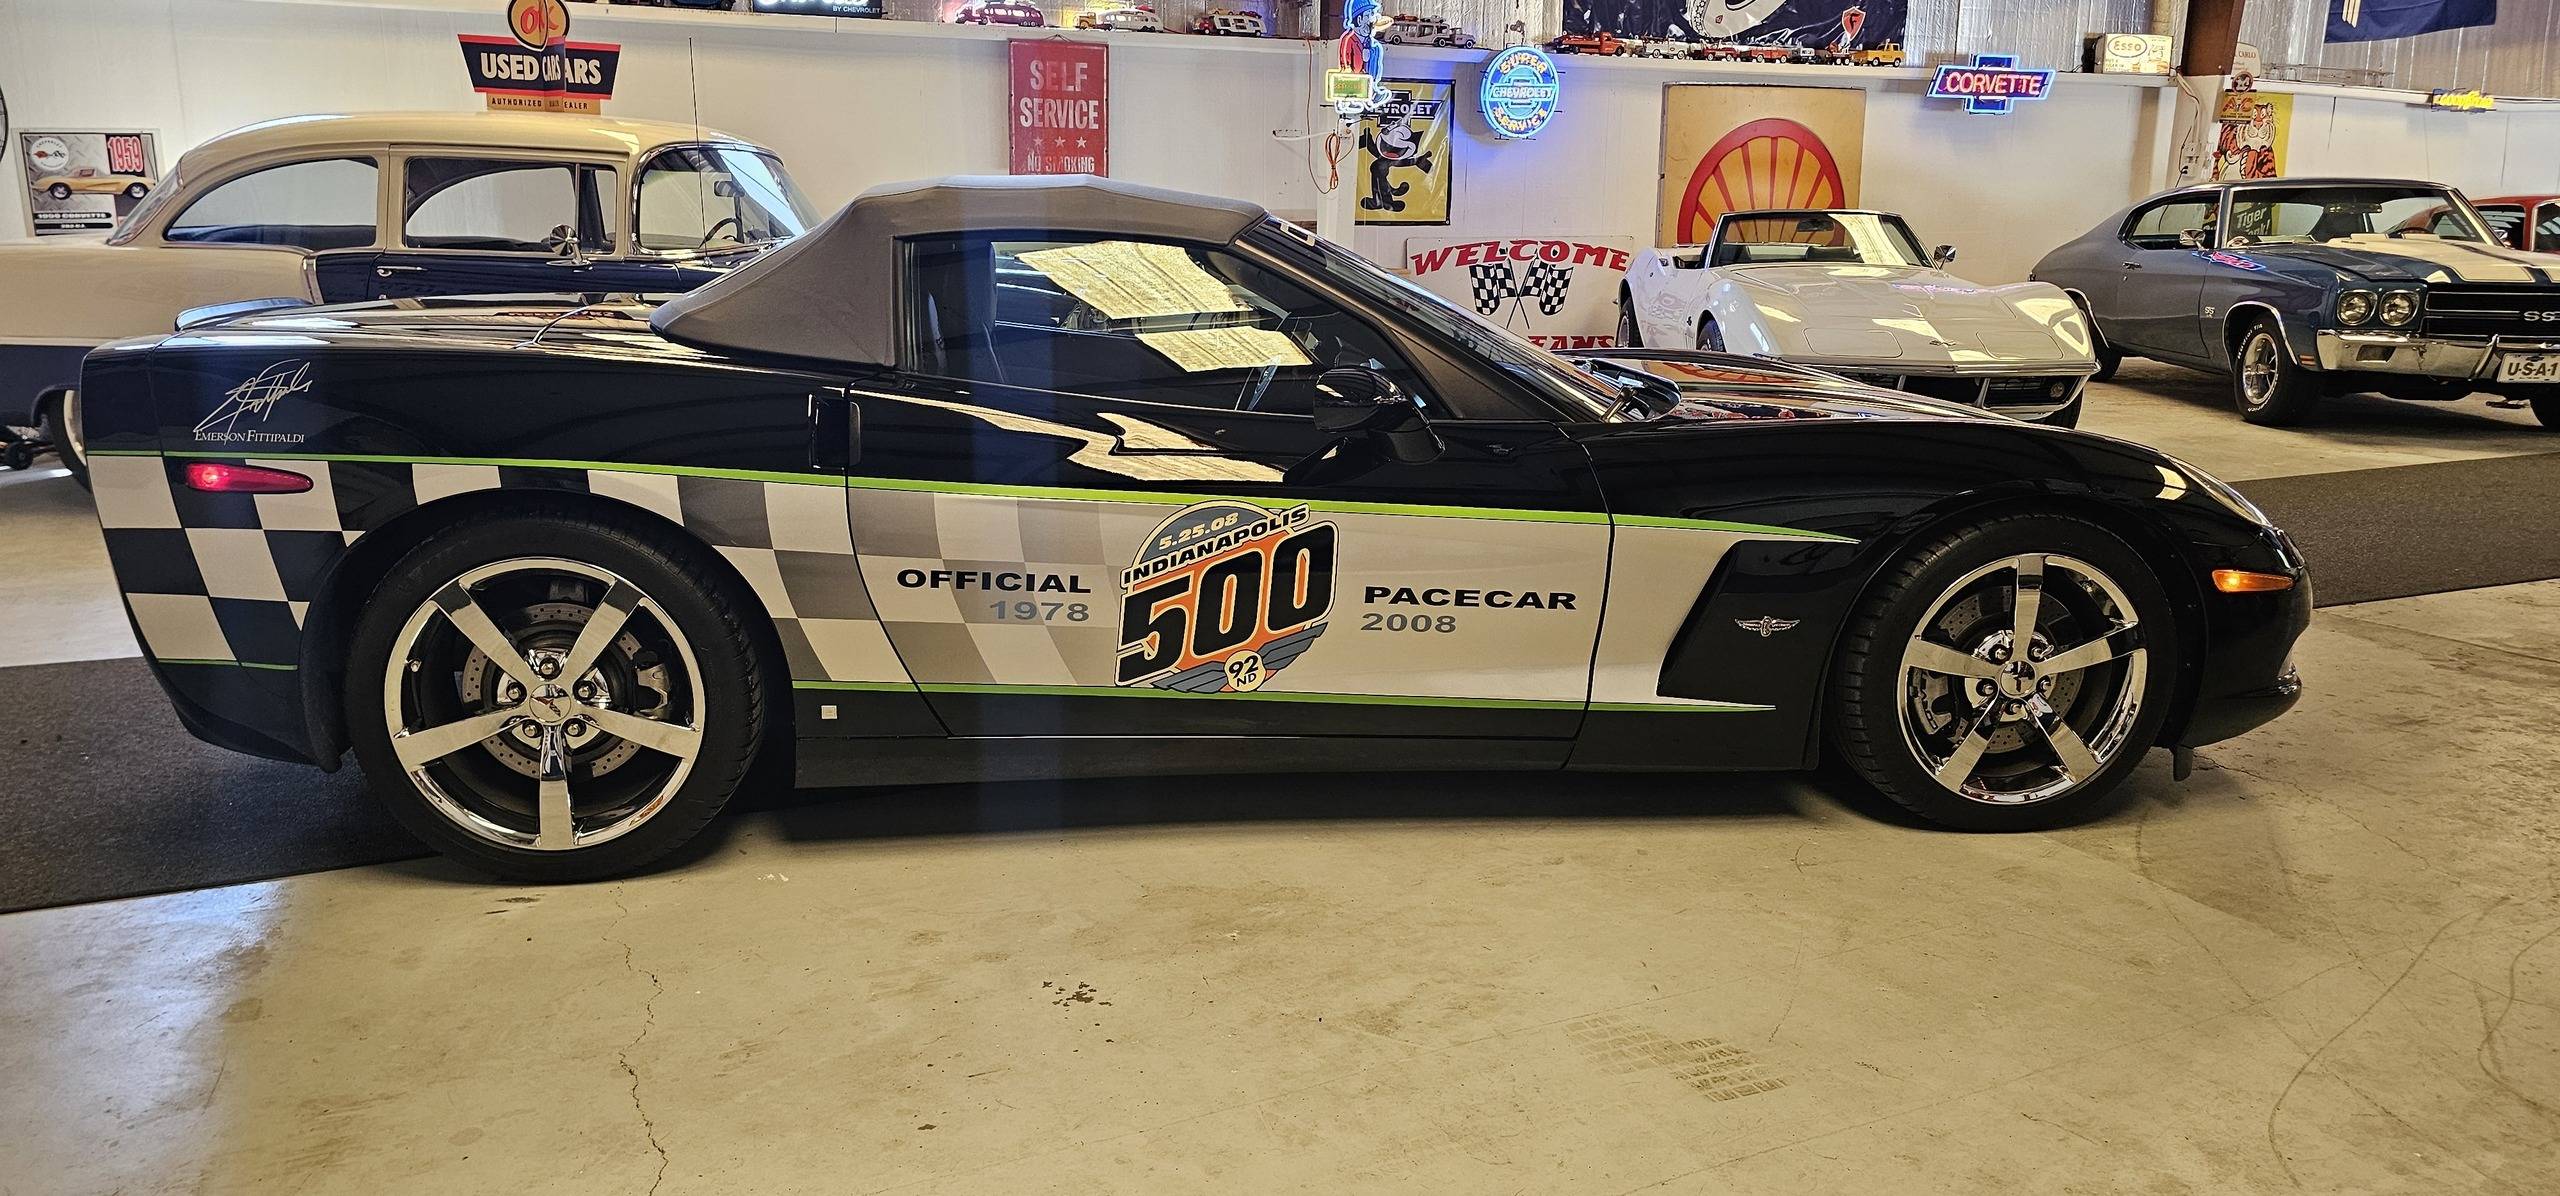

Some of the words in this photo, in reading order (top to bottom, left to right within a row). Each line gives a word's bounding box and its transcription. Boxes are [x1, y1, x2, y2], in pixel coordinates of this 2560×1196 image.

[480, 53, 540, 81] USED
[564, 57, 602, 85] ARS
[1499, 53, 1547, 73] SUPER
[1030, 59, 1088, 92] SELF
[1946, 71, 2043, 95] CORVETTE
[491, 97, 542, 107] AUTHORIZED
[1492, 86, 1552, 98] CHEVROLET
[564, 101, 588, 110] EALER
[1020, 96, 1099, 129] SERVICE
[1493, 107, 1547, 131] SERVICE
[107, 135, 144, 172] 1959
[1027, 150, 1041, 172] NO
[1046, 155, 1095, 173] SMOKING
[2236, 207, 2267, 229] Tiger
[1410, 240, 1631, 276] WELCOME
[2523, 311, 2555, 321] SS
[195, 430, 245, 442] EMERSON
[247, 430, 304, 443] FITTIPALDI
[1159, 512, 1239, 550] 5.25.08
[1124, 506, 1308, 584] INDIANAPOLIS
[897, 569, 1091, 593] OFFICIAL
[1118, 524, 1336, 684] 500
[1364, 586, 1577, 610] PACECAR
[990, 601, 1090, 622] 1978
[1361, 613, 1456, 633] 2008
[1228, 655, 1259, 680] 92
[1236, 672, 1257, 687] ND
